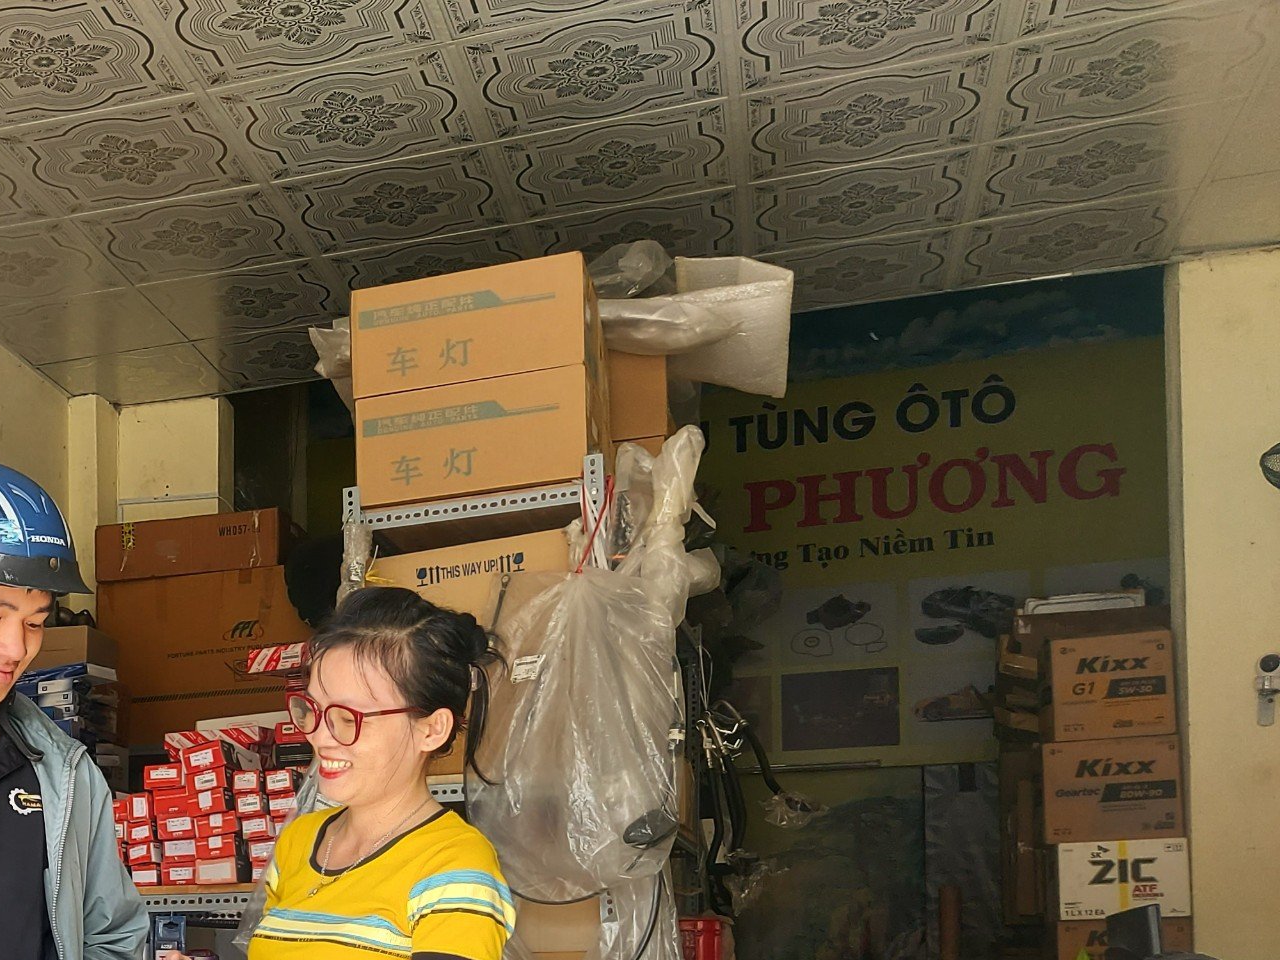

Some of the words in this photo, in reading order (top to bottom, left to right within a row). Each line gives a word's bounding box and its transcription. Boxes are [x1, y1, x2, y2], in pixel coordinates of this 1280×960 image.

[729, 401, 877, 453] TÙNG
[896, 373, 1017, 433] ÔTÔ
[743, 442, 1127, 533] PHƯƠNG
[218, 524, 261, 537] WH057-
[31, 535, 66, 546] HONDA
[797, 543, 850, 569] Tạo
[860, 528, 935, 558] Niềm
[944, 527, 995, 550] Tin
[441, 564, 460, 580] THIS
[462, 562, 482, 577] WAY
[484, 558, 499, 573] UP!
[167, 651, 194, 660] FORTUNE
[195, 648, 214, 656] PARTS
[215, 645, 246, 655] INDUSTRY
[1076, 655, 1151, 675] Kixx
[1072, 681, 1095, 696] G1
[1118, 685, 1153, 695] 5W-30
[1075, 758, 1156, 778] Kixx
[1056, 787, 1101, 798] Geartec
[1088, 857, 1159, 885] ZIC
[1132, 884, 1158, 893] ATF
